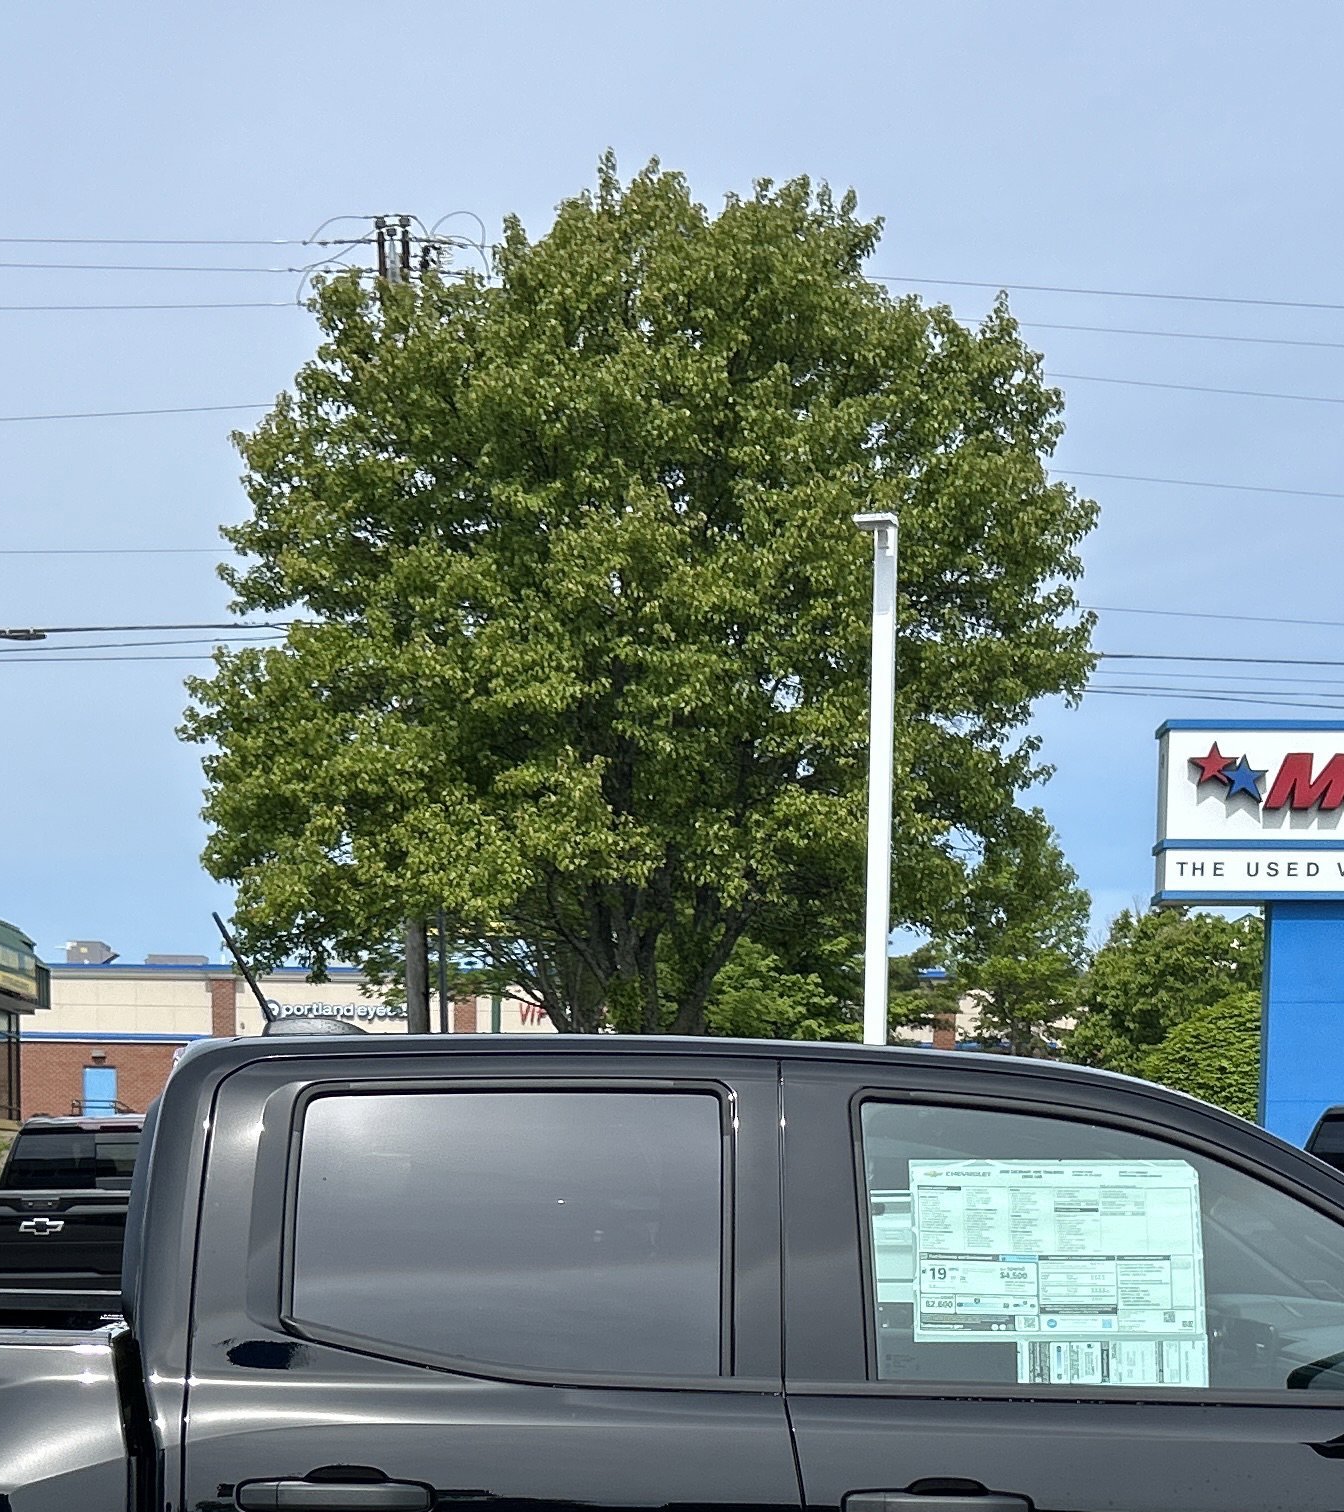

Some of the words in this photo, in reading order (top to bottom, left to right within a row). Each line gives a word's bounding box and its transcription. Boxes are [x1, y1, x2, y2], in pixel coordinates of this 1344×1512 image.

[1176, 862, 1225, 877] THE
[1246, 862, 1321, 877] USED
[281, 1002, 355, 1017] portland
[929, 1267, 947, 1280] 19
